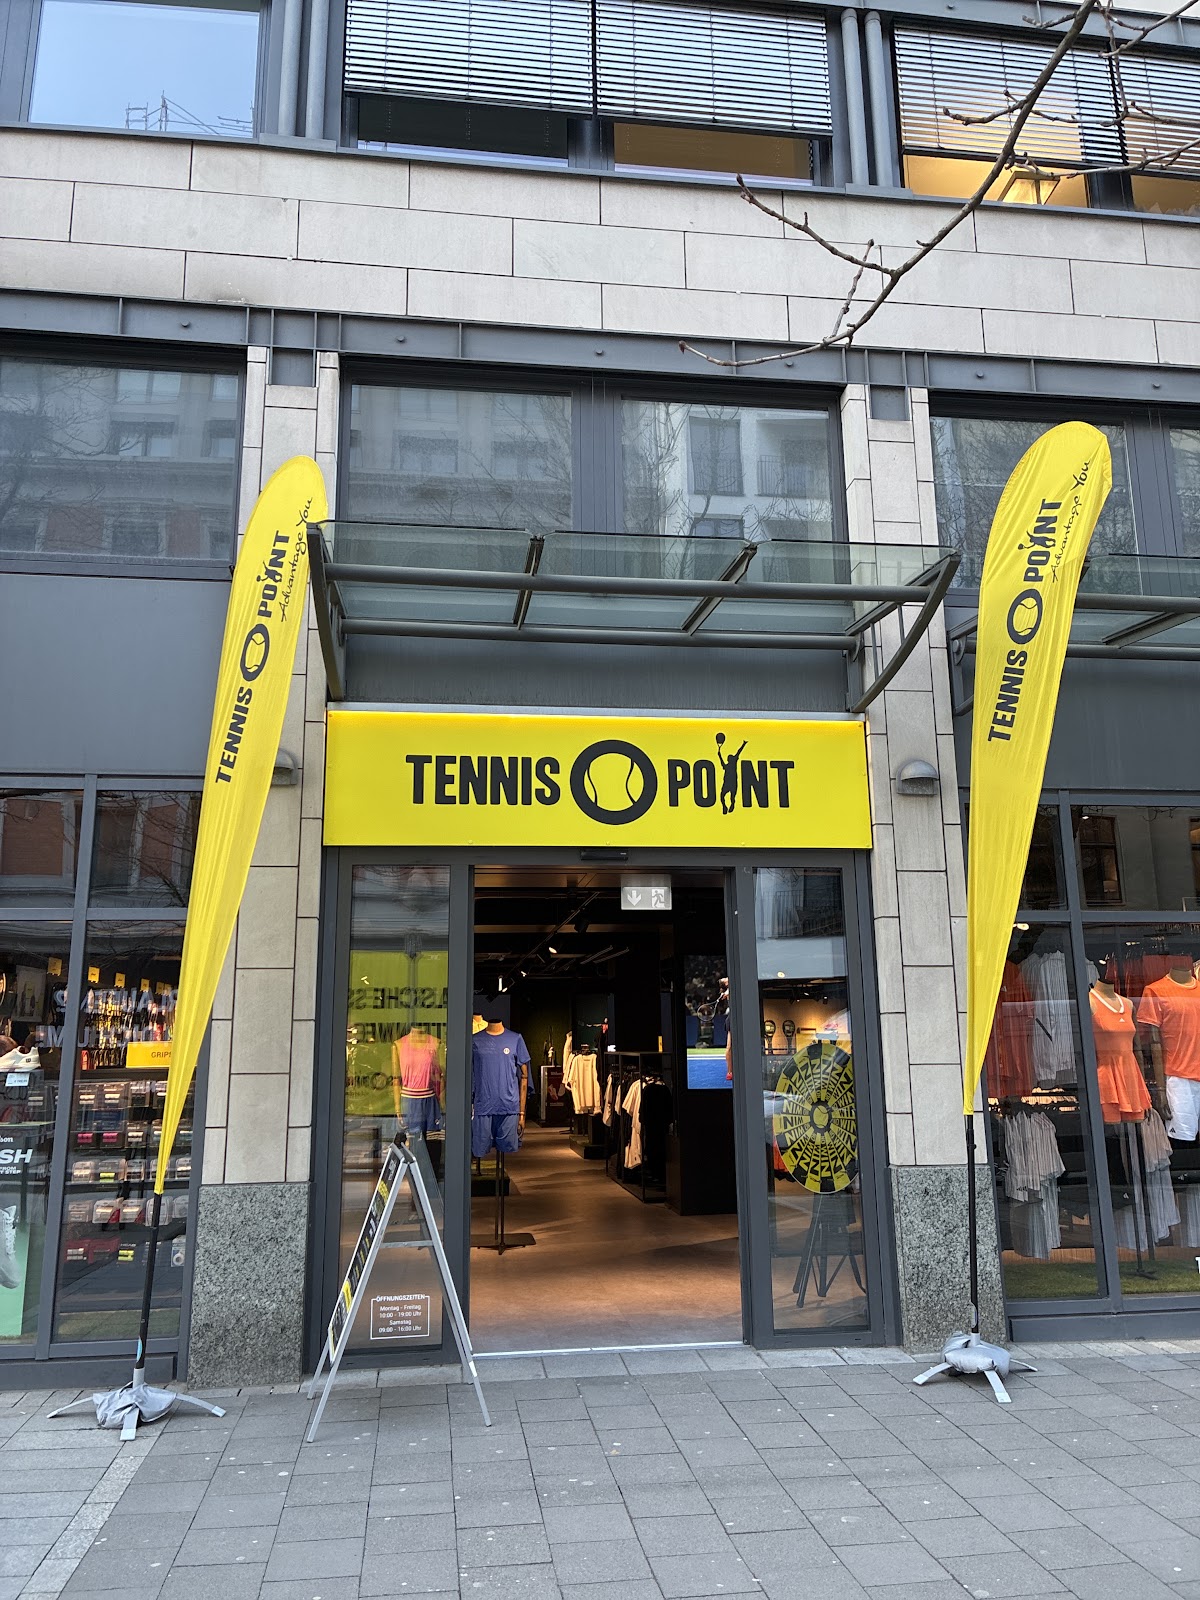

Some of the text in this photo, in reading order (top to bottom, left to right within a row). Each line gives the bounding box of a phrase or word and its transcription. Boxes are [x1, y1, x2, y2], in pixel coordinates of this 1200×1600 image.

[281, 497, 312, 622] Advantage You
[1051, 460, 1090, 583] Advantage You
[215, 686, 253, 783] TENNIS
[988, 649, 1027, 742] TENNIS
[406, 755, 561, 806] TENNIS
